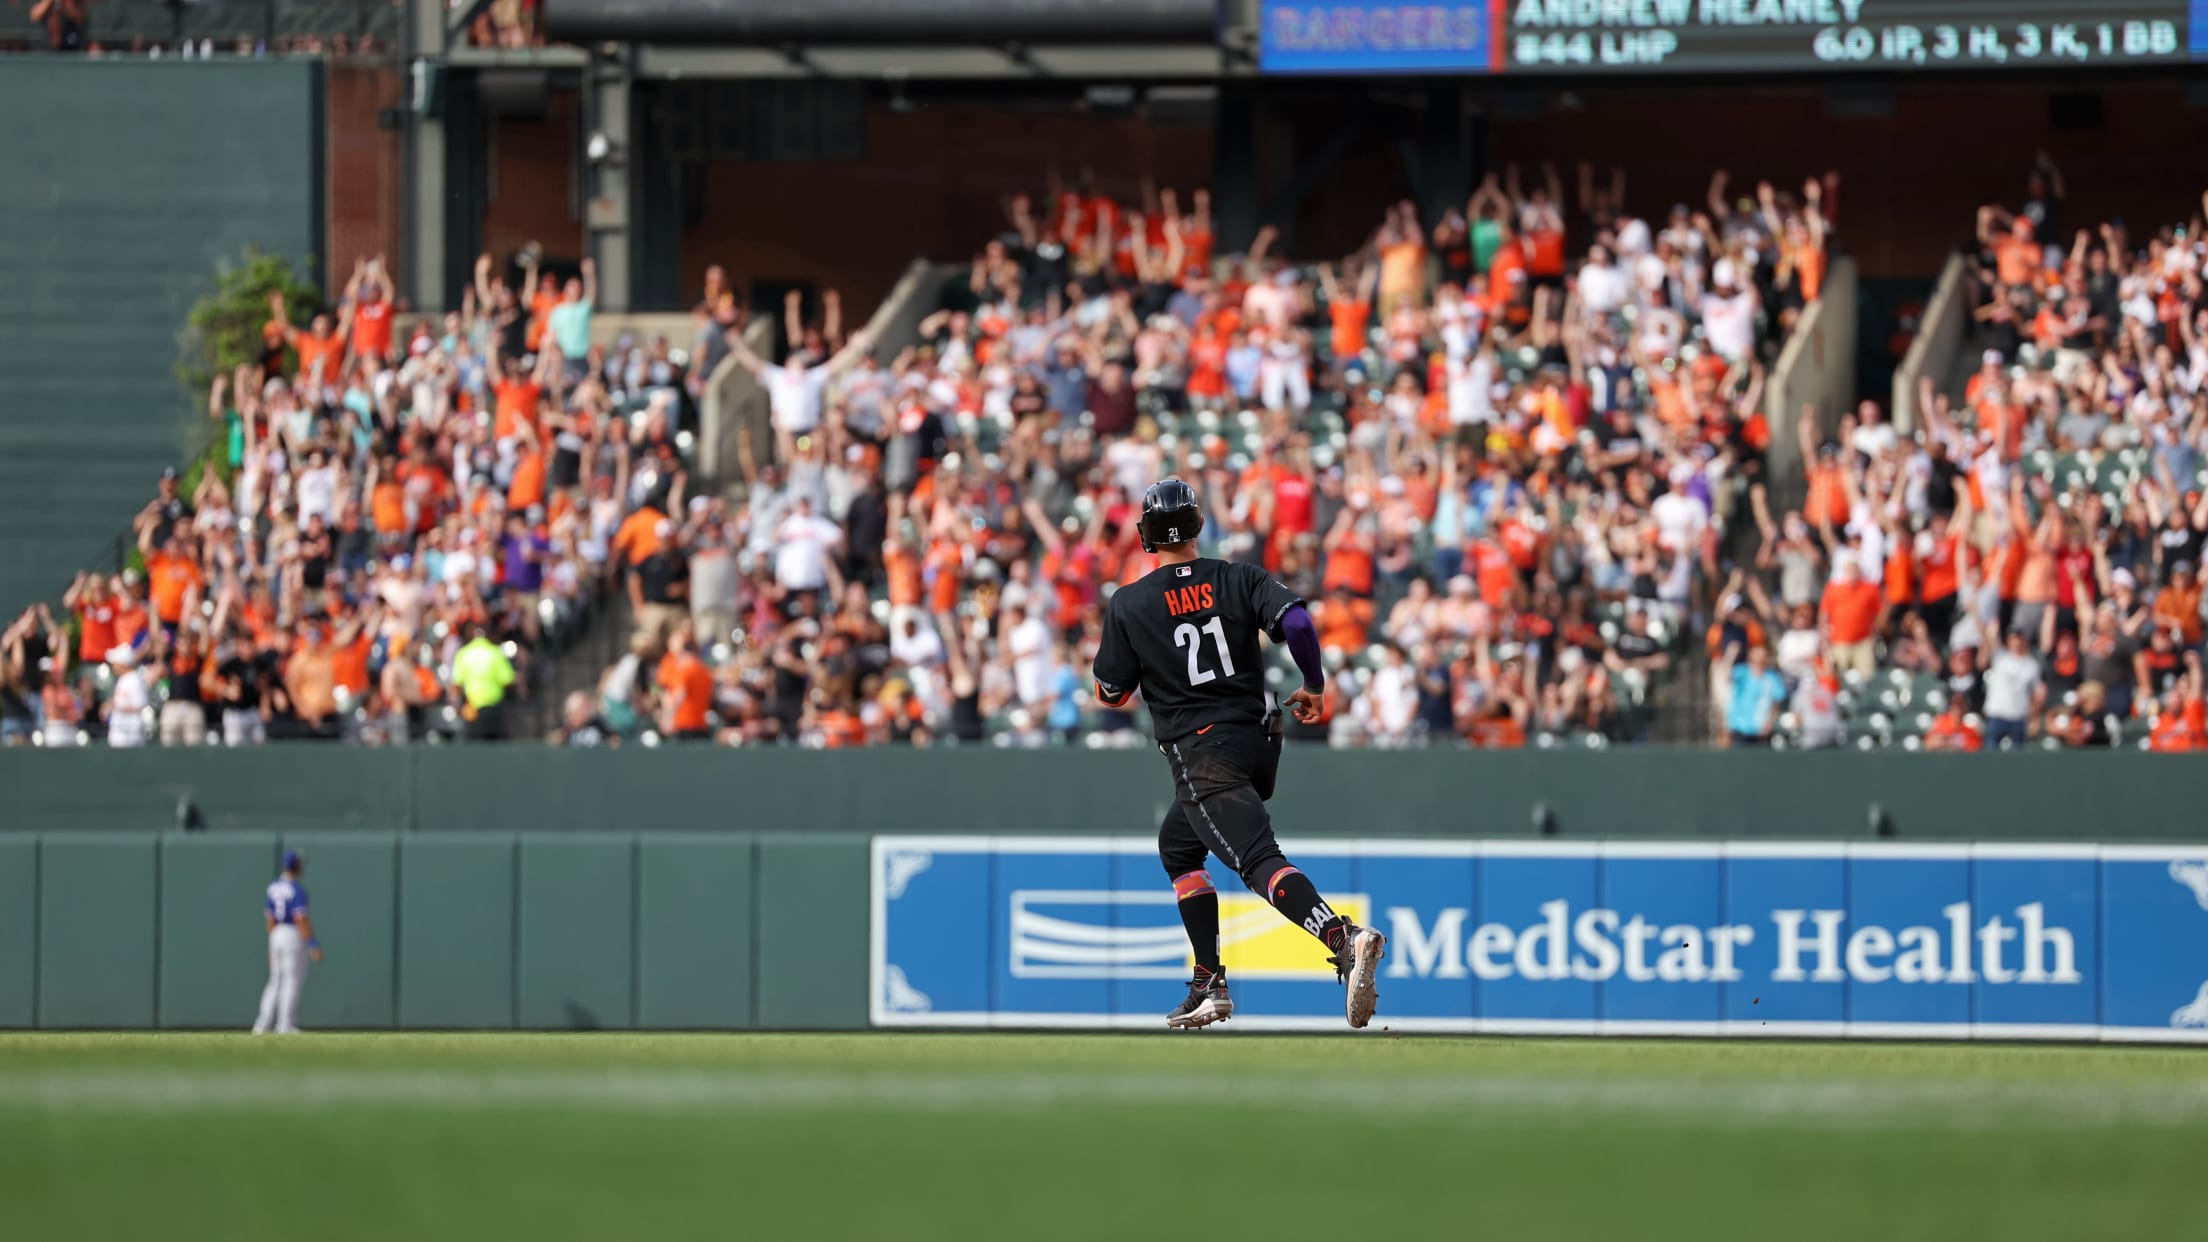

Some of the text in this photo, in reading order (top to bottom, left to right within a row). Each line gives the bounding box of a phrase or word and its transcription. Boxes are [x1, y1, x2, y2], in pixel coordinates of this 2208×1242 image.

[1274, 5, 1481, 50] RANGERS
[1513, 0, 1692, 27] ANDREW
[1600, 29, 1678, 64] LHP
[1881, 25, 1926, 65] IP,
[1933, 24, 1960, 59] 3
[1968, 25, 2008, 64] H,
[2015, 23, 2042, 57] 3
[2051, 23, 2089, 62] K,
[2097, 22, 2113, 56] 1
[2123, 20, 2178, 55] BB
[1168, 527, 1179, 537] 21
[1164, 582, 1215, 617] HAYS
[1174, 616, 1236, 687] 21
[1304, 902, 1337, 938] BAL
[1385, 898, 2082, 984] MedStar Health
